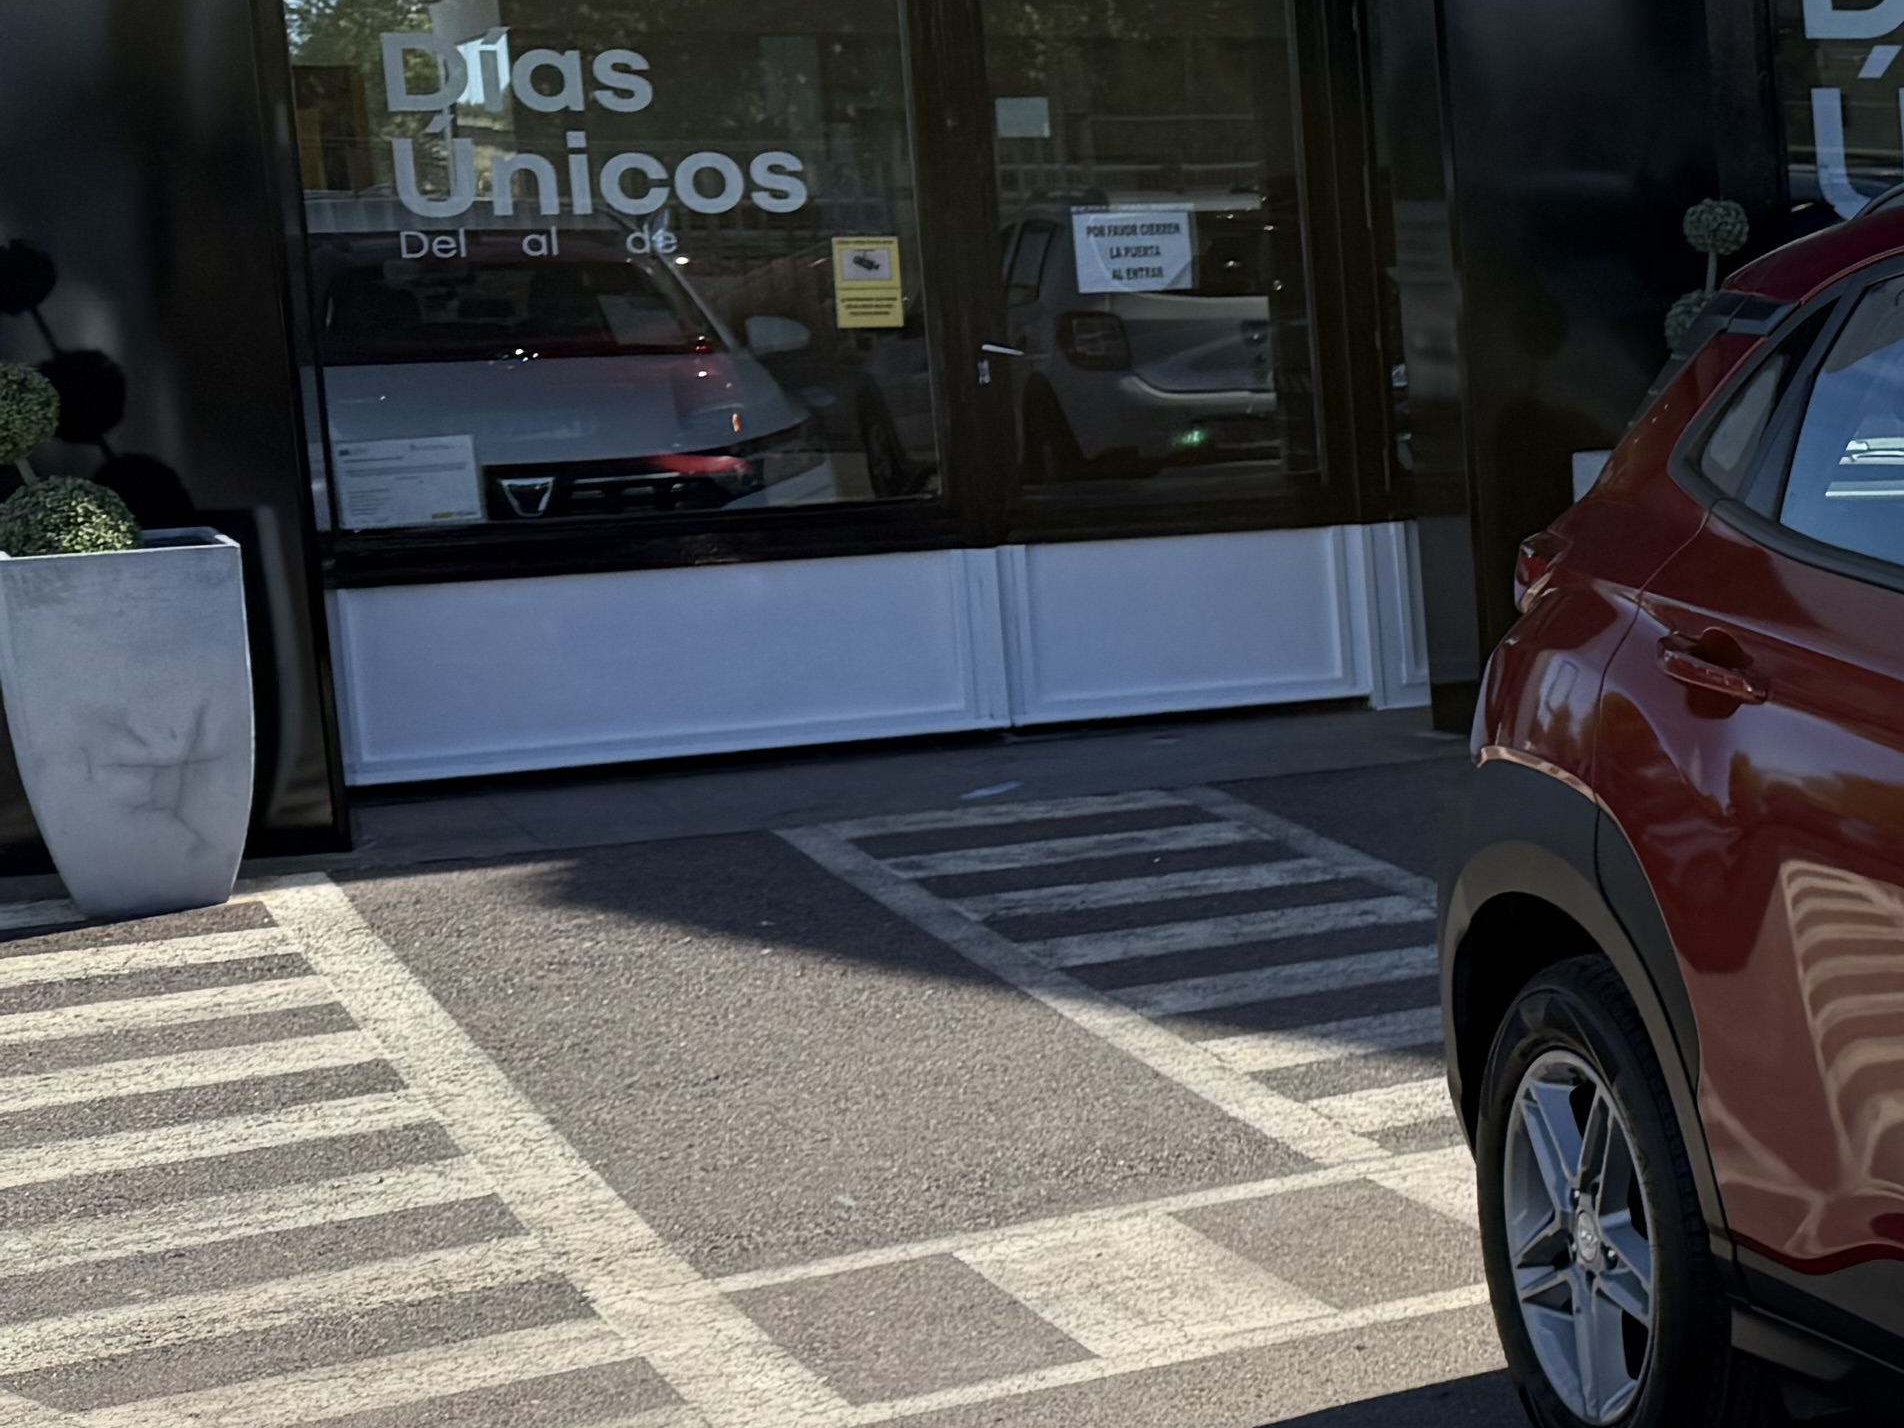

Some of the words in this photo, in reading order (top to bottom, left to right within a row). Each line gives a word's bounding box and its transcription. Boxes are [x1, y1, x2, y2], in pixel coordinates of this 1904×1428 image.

[380, 25, 654, 113] Días
[392, 112, 808, 218] Únicos
[400, 229, 467, 259] Del
[522, 227, 559, 257] al
[626, 225, 678, 255] de
[1124, 246, 1160, 258] PUERTA
